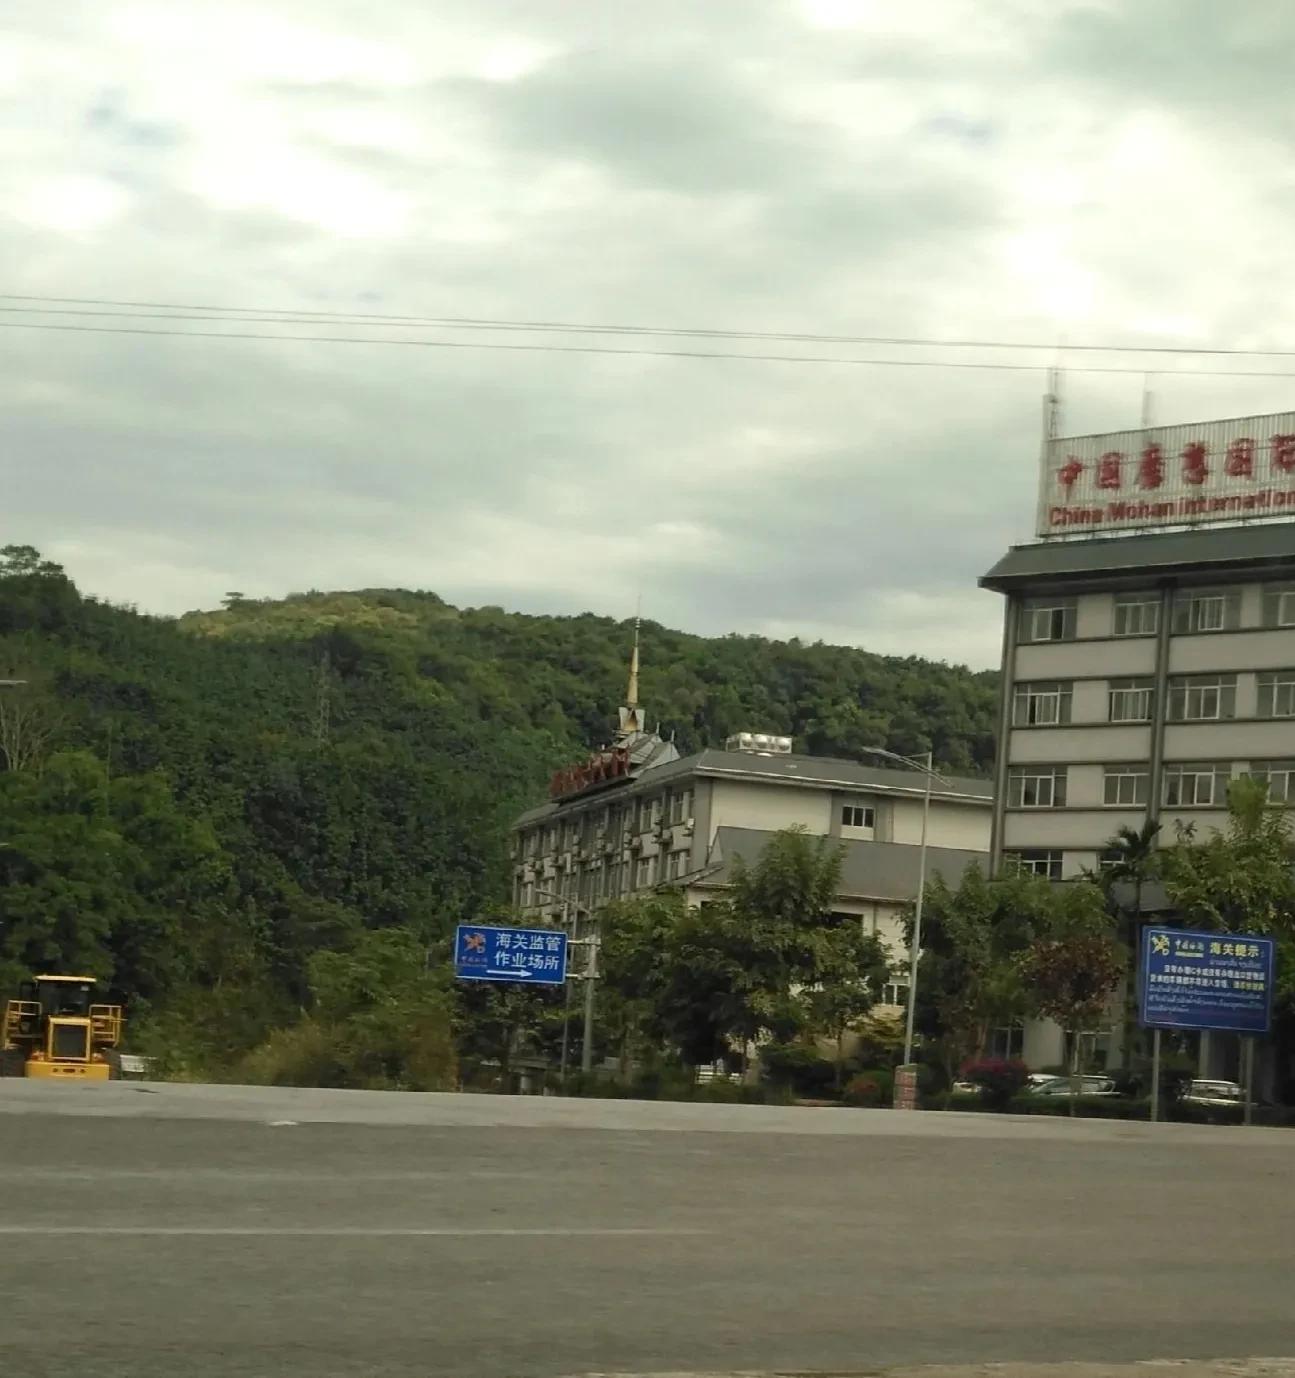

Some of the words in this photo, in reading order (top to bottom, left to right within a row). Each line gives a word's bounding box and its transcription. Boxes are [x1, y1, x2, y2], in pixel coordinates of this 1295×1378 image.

[1051, 505, 1104, 526] China
[1107, 500, 1174, 521] Mohan
[495, 932, 562, 951] 海关监管
[1210, 942, 1259, 957] 海关提示
[494, 951, 560, 970] 作业场所
